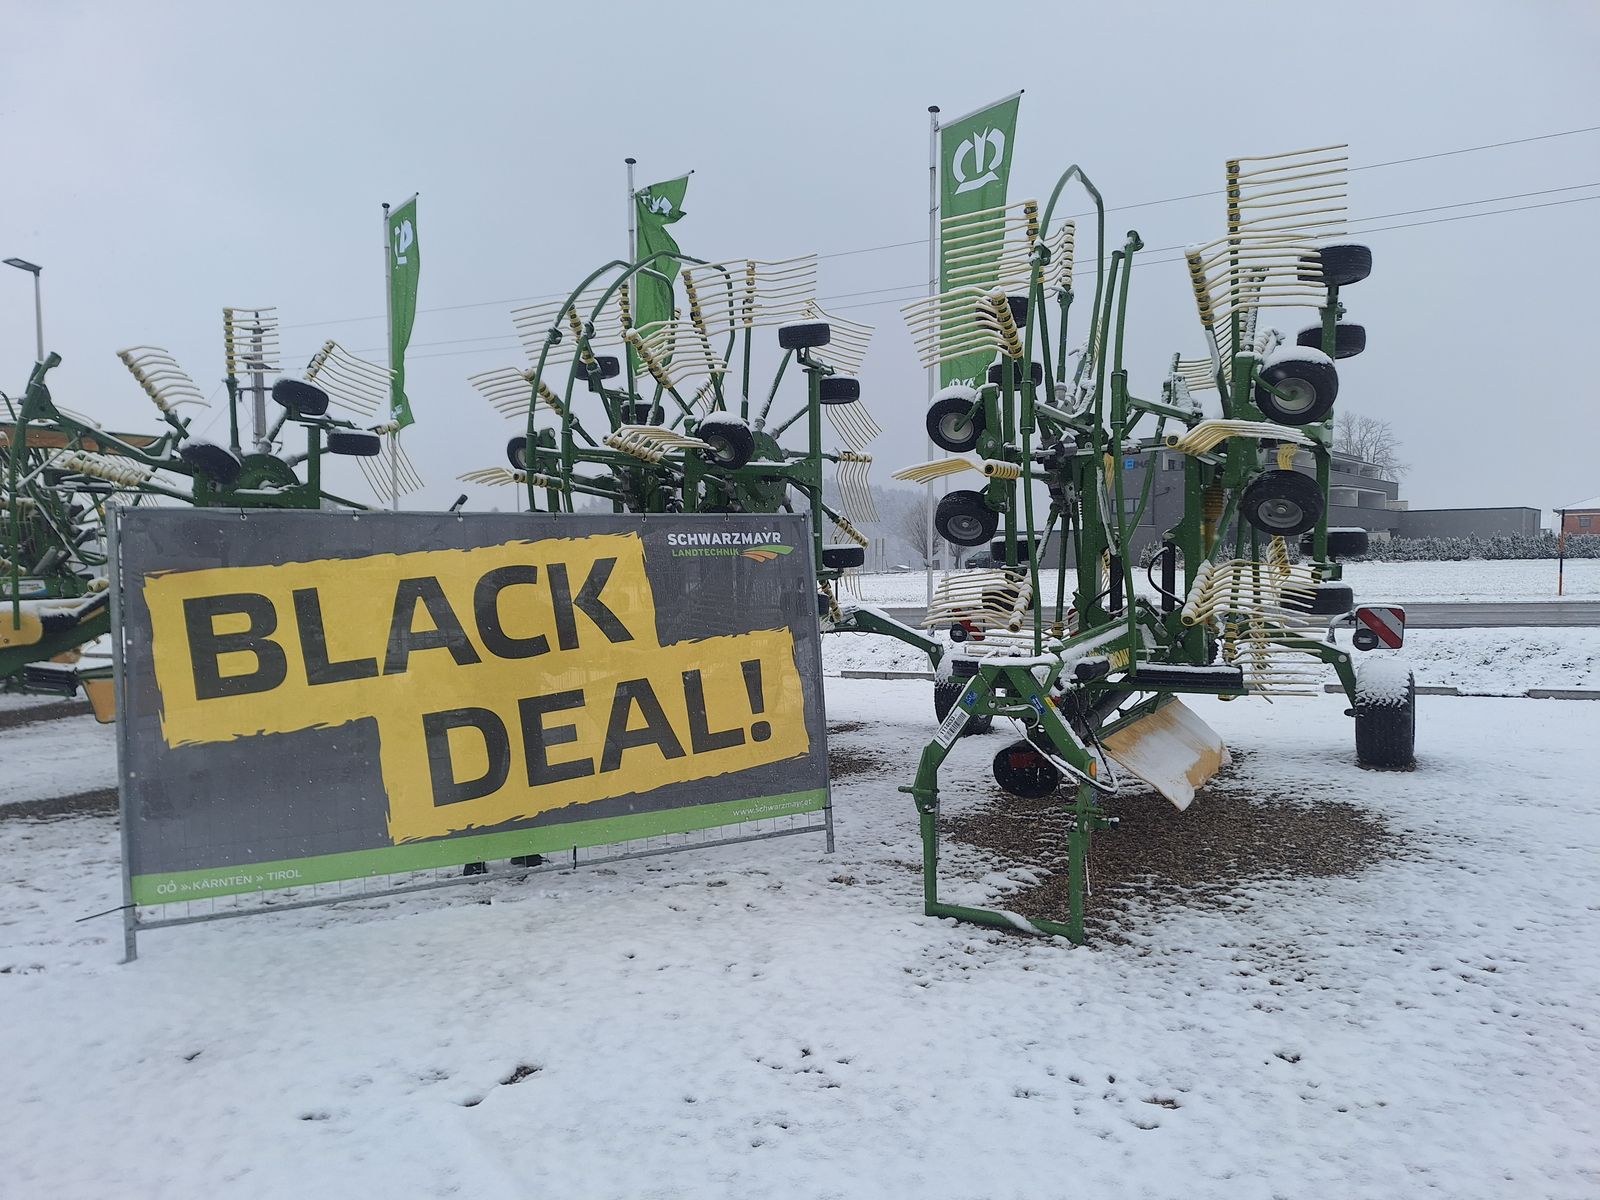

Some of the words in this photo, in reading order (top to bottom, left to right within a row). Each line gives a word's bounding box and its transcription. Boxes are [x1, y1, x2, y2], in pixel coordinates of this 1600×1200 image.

[667, 532, 782, 546] SCHWARZMAYR
[672, 547, 740, 557] LANDTECHNIK
[182, 556, 635, 702] BLACK
[421, 658, 772, 808] DEAL!
[732, 799, 812, 816] www.schwarzmayr.at
[191, 875, 253, 890] KÄRNTEN
[266, 869, 302, 881] TIROL
